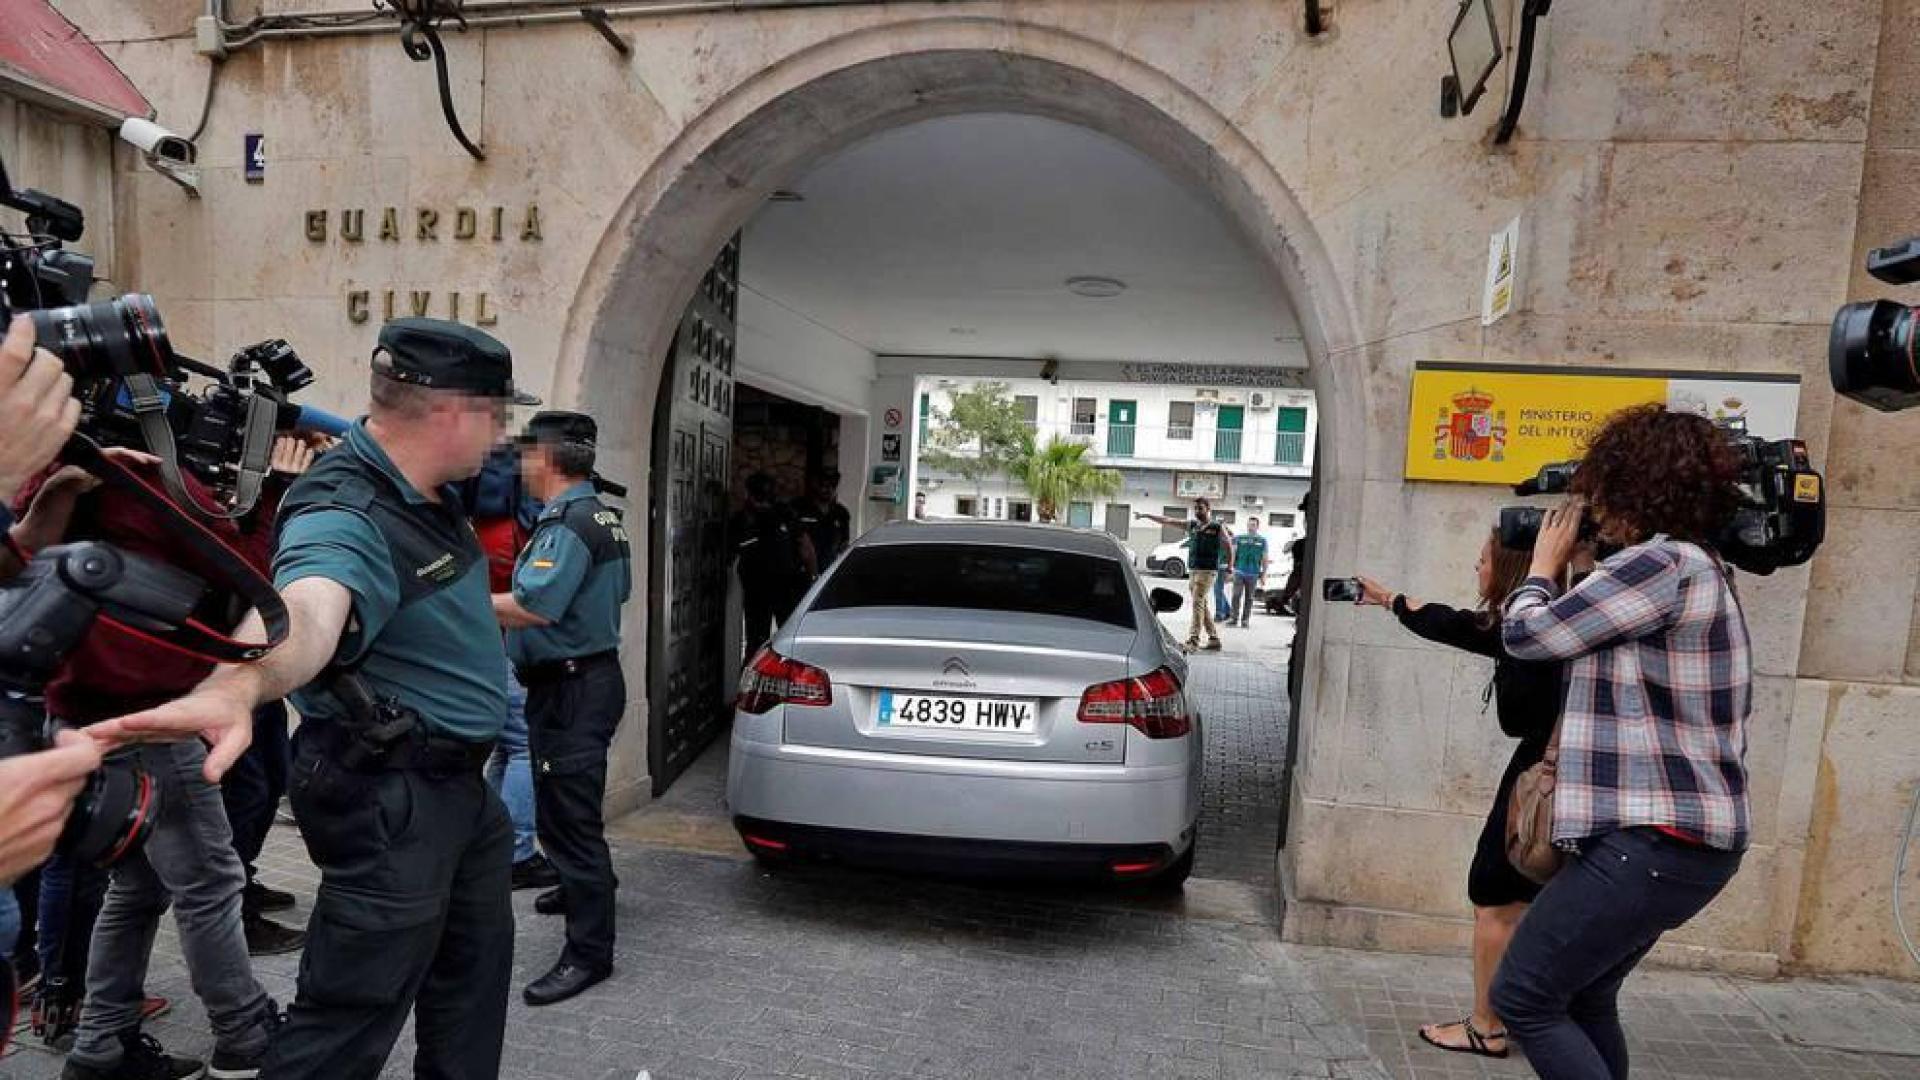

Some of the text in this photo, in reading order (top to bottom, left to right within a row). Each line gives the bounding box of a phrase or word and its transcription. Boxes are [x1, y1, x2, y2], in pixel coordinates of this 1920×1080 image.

[305, 204, 543, 242] GUARDIA
[349, 290, 497, 325] CIVIL
[1520, 409, 1592, 422] MINISTERIO
[1518, 425, 1597, 441] DEL INTERI
[900, 698, 965, 724] 4839
[976, 702, 1026, 729] HWV
